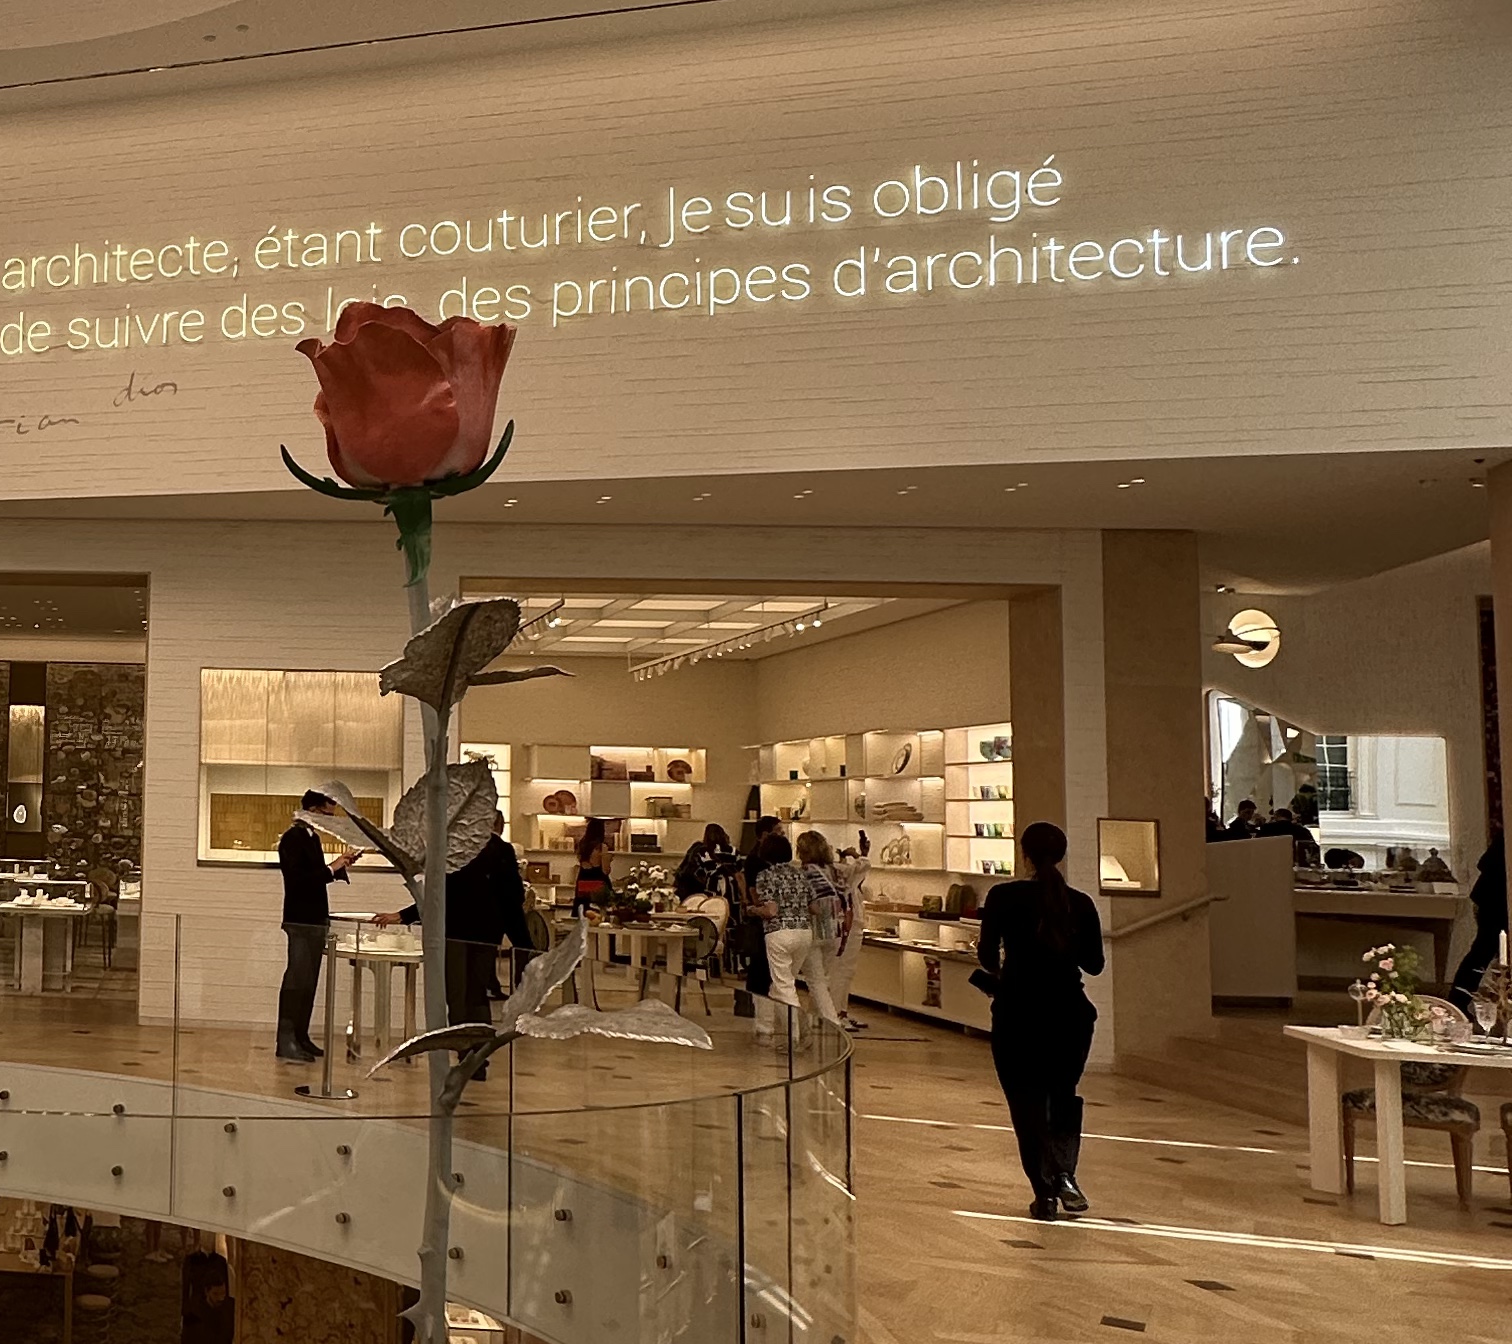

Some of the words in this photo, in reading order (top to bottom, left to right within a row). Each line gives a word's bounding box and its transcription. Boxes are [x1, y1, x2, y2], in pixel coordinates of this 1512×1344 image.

[1, 235, 238, 290] architecte,
[254, 221, 384, 270] étant
[399, 195, 646, 258] couturier,
[659, 186, 714, 248] Je
[725, 174, 852, 228] suis
[873, 154, 1063, 222] obligé
[0, 311, 52, 355] de
[66, 303, 205, 350] suivre
[221, 293, 305, 339] des
[438, 275, 532, 323] des
[552, 257, 811, 328] principes
[833, 226, 1300, 297] d'architecture.
